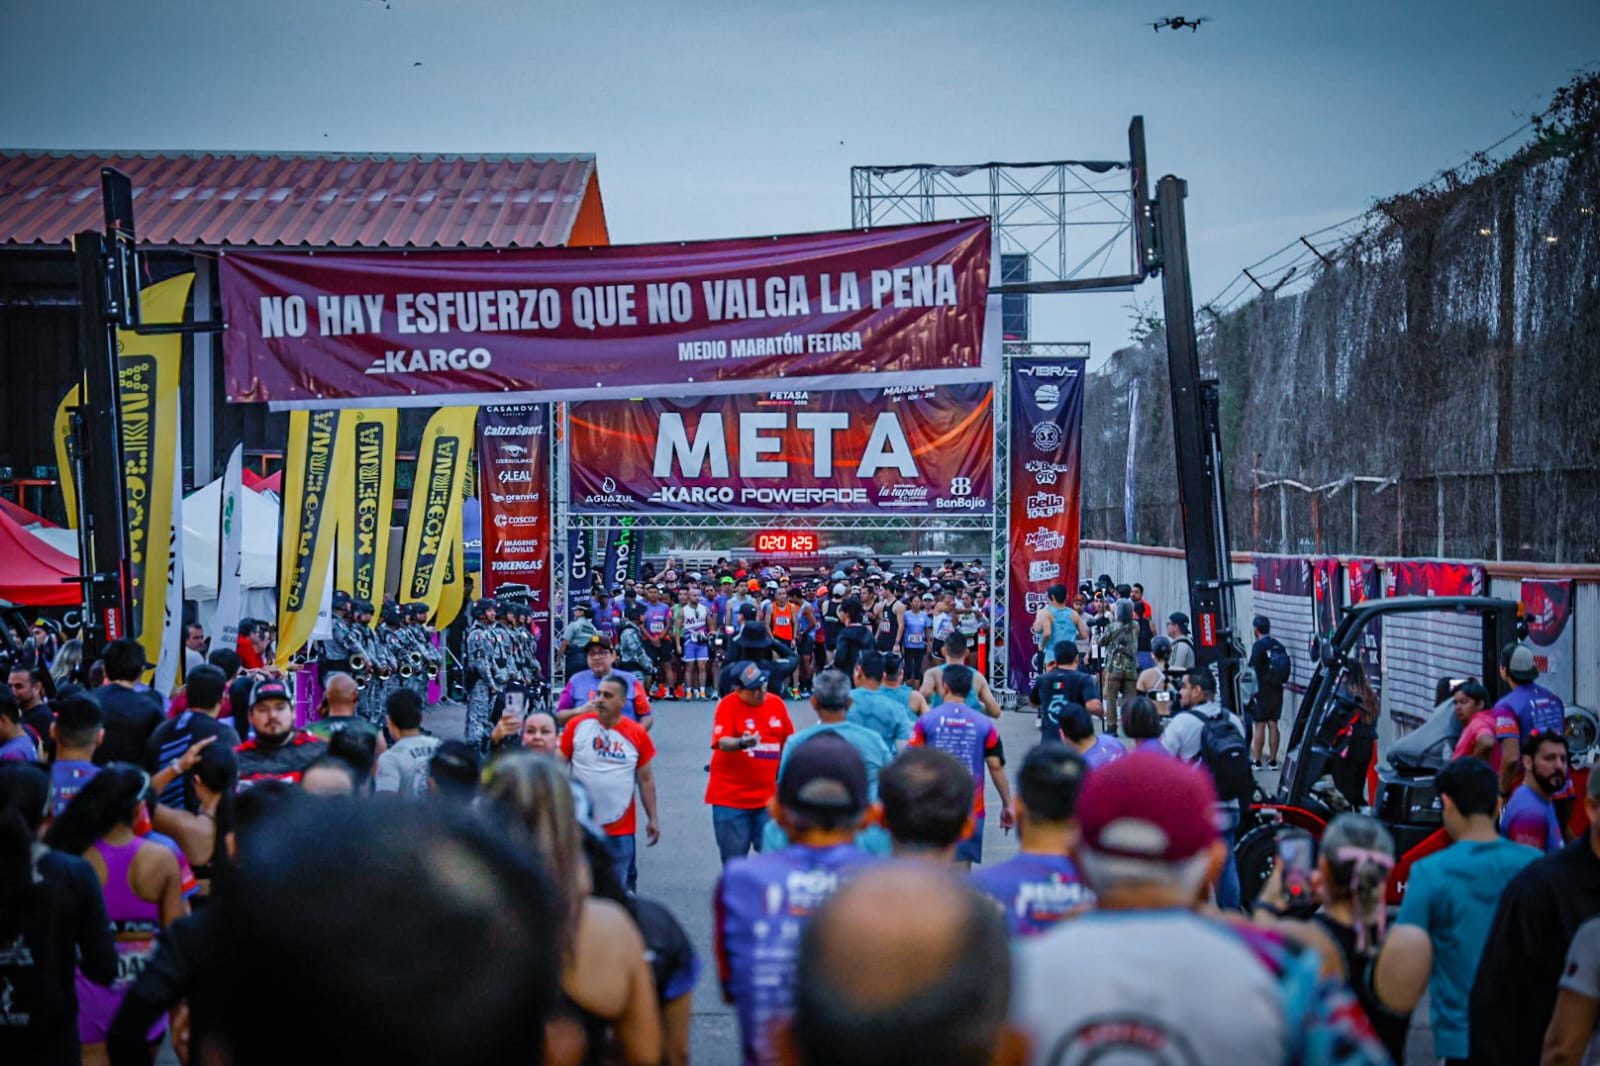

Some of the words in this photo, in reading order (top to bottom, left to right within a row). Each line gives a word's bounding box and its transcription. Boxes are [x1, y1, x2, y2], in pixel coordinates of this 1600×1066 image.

[260, 296, 308, 338] NO
[318, 294, 384, 336] HAY
[396, 288, 562, 334] ESFUERZO
[571, 283, 637, 331] QUE
[647, 282, 692, 325] NO
[702, 275, 811, 321] VALGA
[819, 271, 863, 314] LA
[871, 264, 958, 310] PENA
[678, 339, 727, 361] MEDIO
[730, 332, 804, 358] MARATÓN
[807, 331, 862, 354] FETASA
[384, 347, 492, 374] KARGO
[1018, 365, 1078, 377] VIBRA
[769, 391, 809, 400] FETASA
[486, 405, 540, 413] CASANOVA
[653, 411, 920, 478] META
[508, 470, 532, 481] LEAL
[357, 426, 380, 556] MODERNA
[420, 440, 456, 556] MODERNA
[585, 494, 635, 503] AGUAZUL
[661, 486, 734, 503] KARGO
[741, 487, 867, 503] POWERADE
[936, 497, 986, 511] BanBajío
[1028, 495, 1064, 509] Bella
